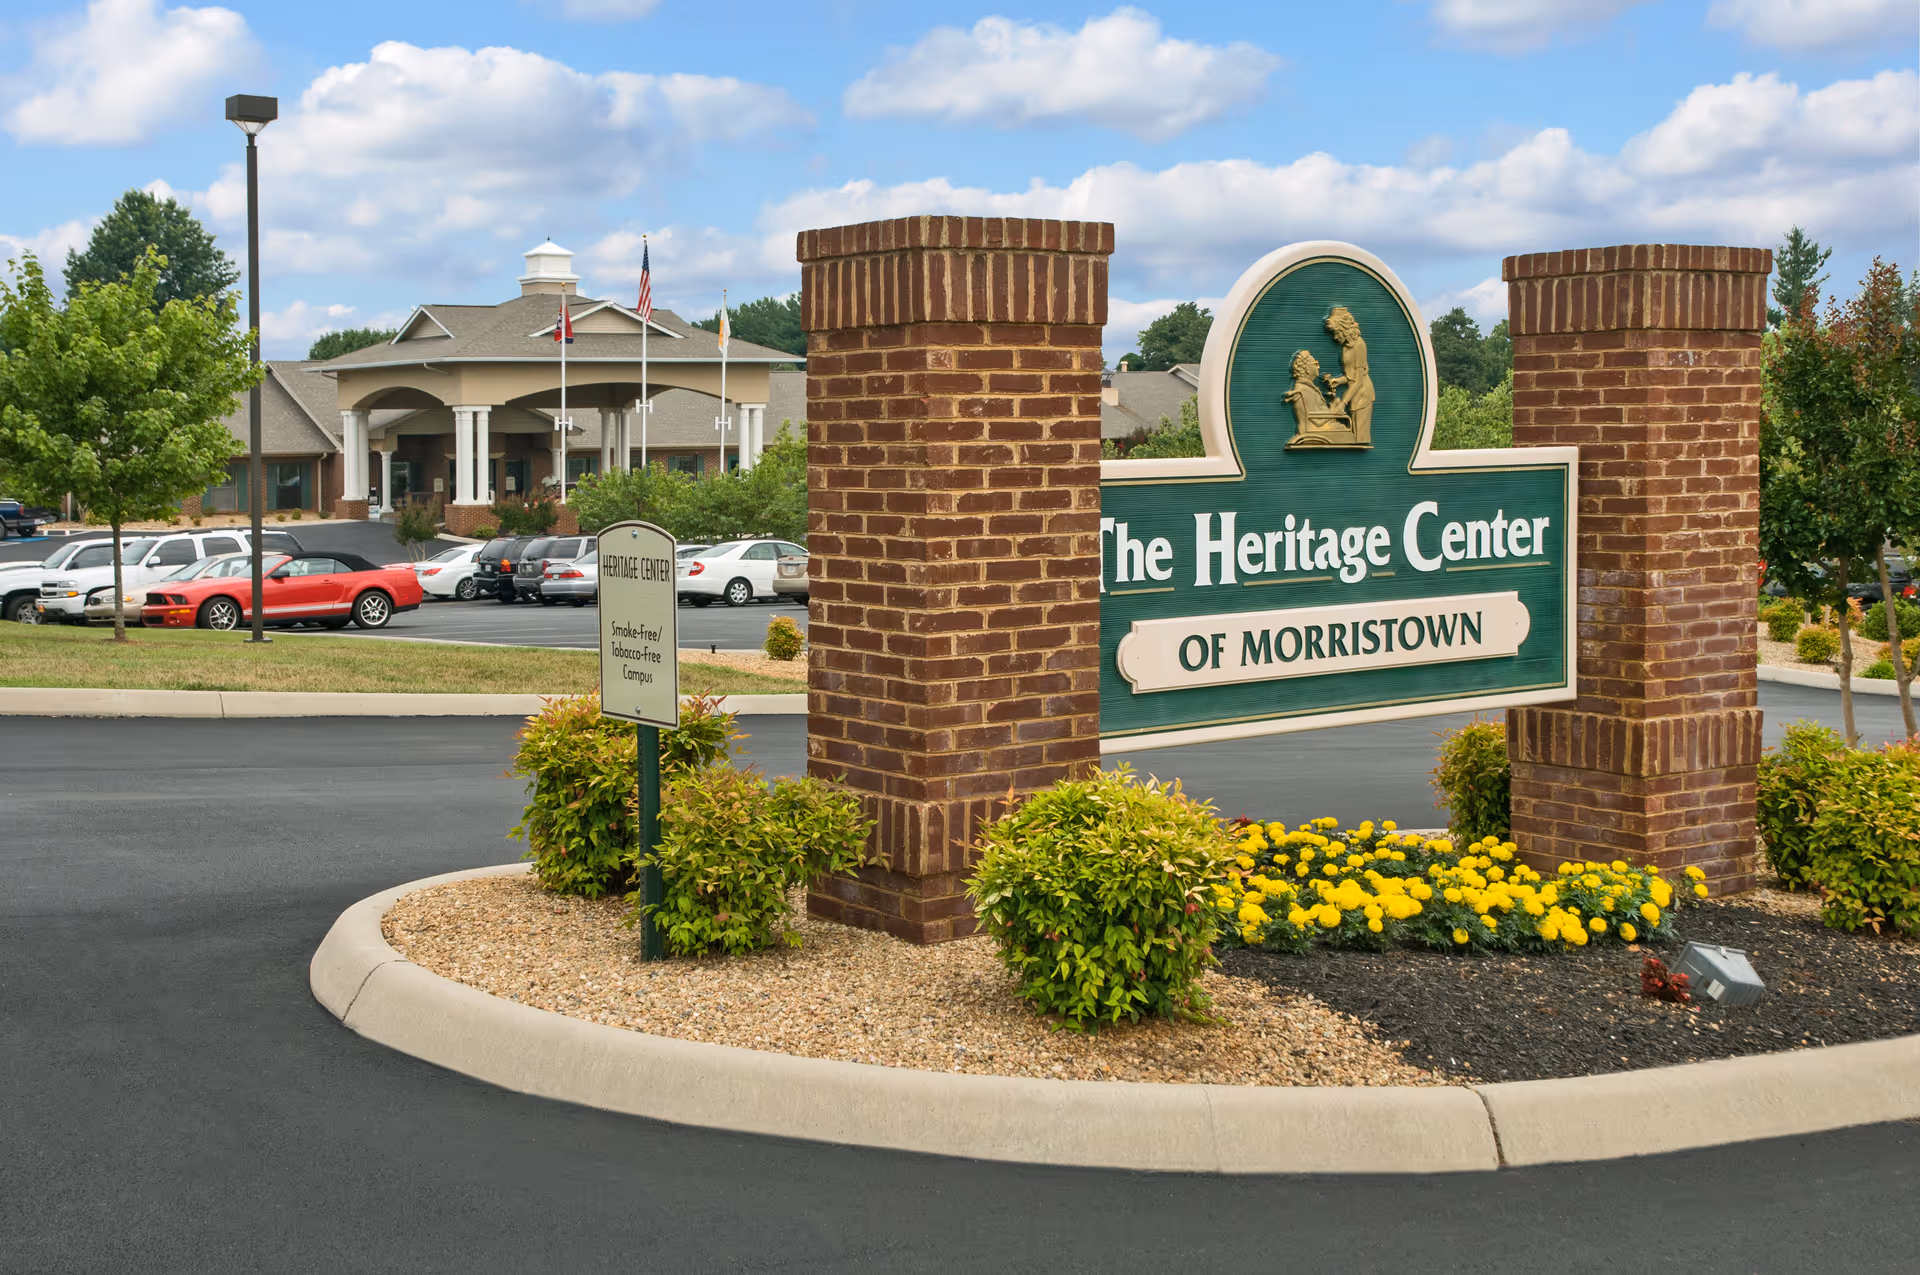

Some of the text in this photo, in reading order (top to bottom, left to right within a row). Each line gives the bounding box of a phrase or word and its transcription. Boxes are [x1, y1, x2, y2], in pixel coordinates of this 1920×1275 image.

[1193, 511, 1391, 587] Heritage
[1403, 500, 1550, 572] Center
[603, 555, 670, 582] HERITAGE CENTER
[611, 620, 662, 643] Smoke-Free/
[1178, 611, 1482, 672] OF MORRISTOWN
[611, 641, 661, 664] Tobacco-Free
[623, 664, 653, 686] Campus
